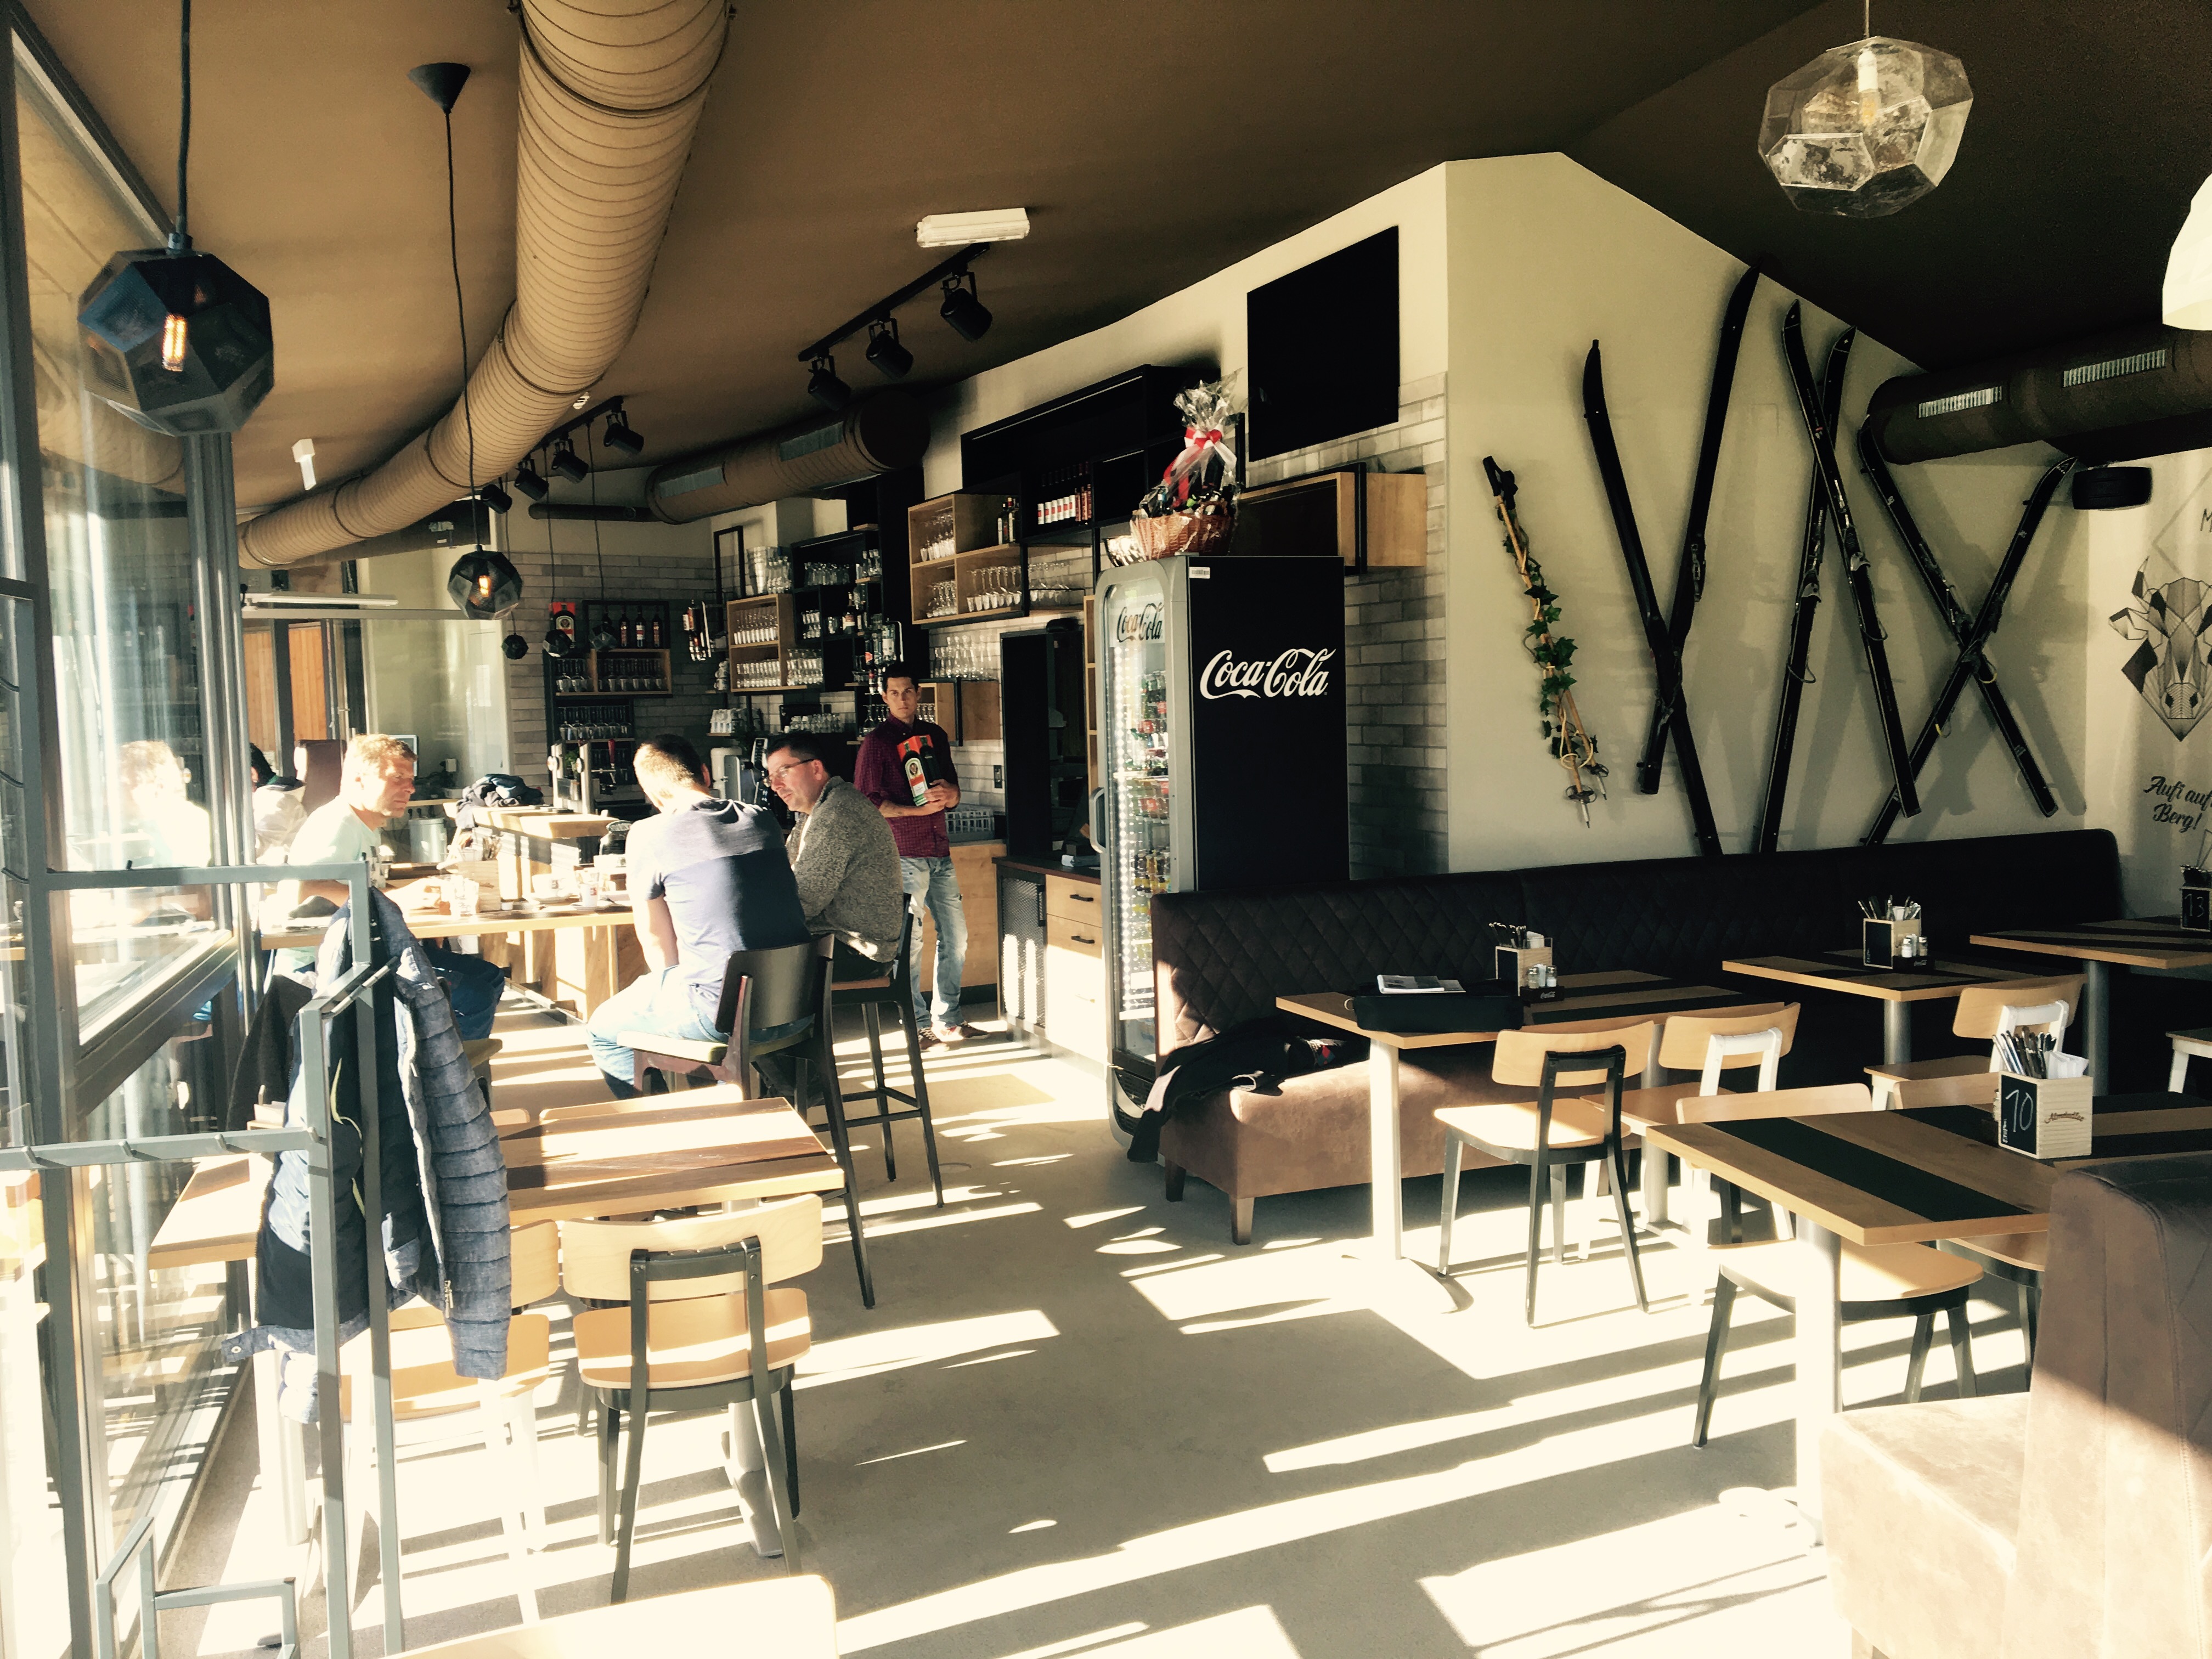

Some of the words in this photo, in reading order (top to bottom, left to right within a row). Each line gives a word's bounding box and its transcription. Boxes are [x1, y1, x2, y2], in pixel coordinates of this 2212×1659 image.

[1200, 648, 1336, 699] Coca-Cola
[2143, 776, 2186, 803] Aufi
[2152, 803, 2203, 833] Berg!
[2184, 893, 2205, 918] 13
[2005, 1089, 2034, 1132] 10
